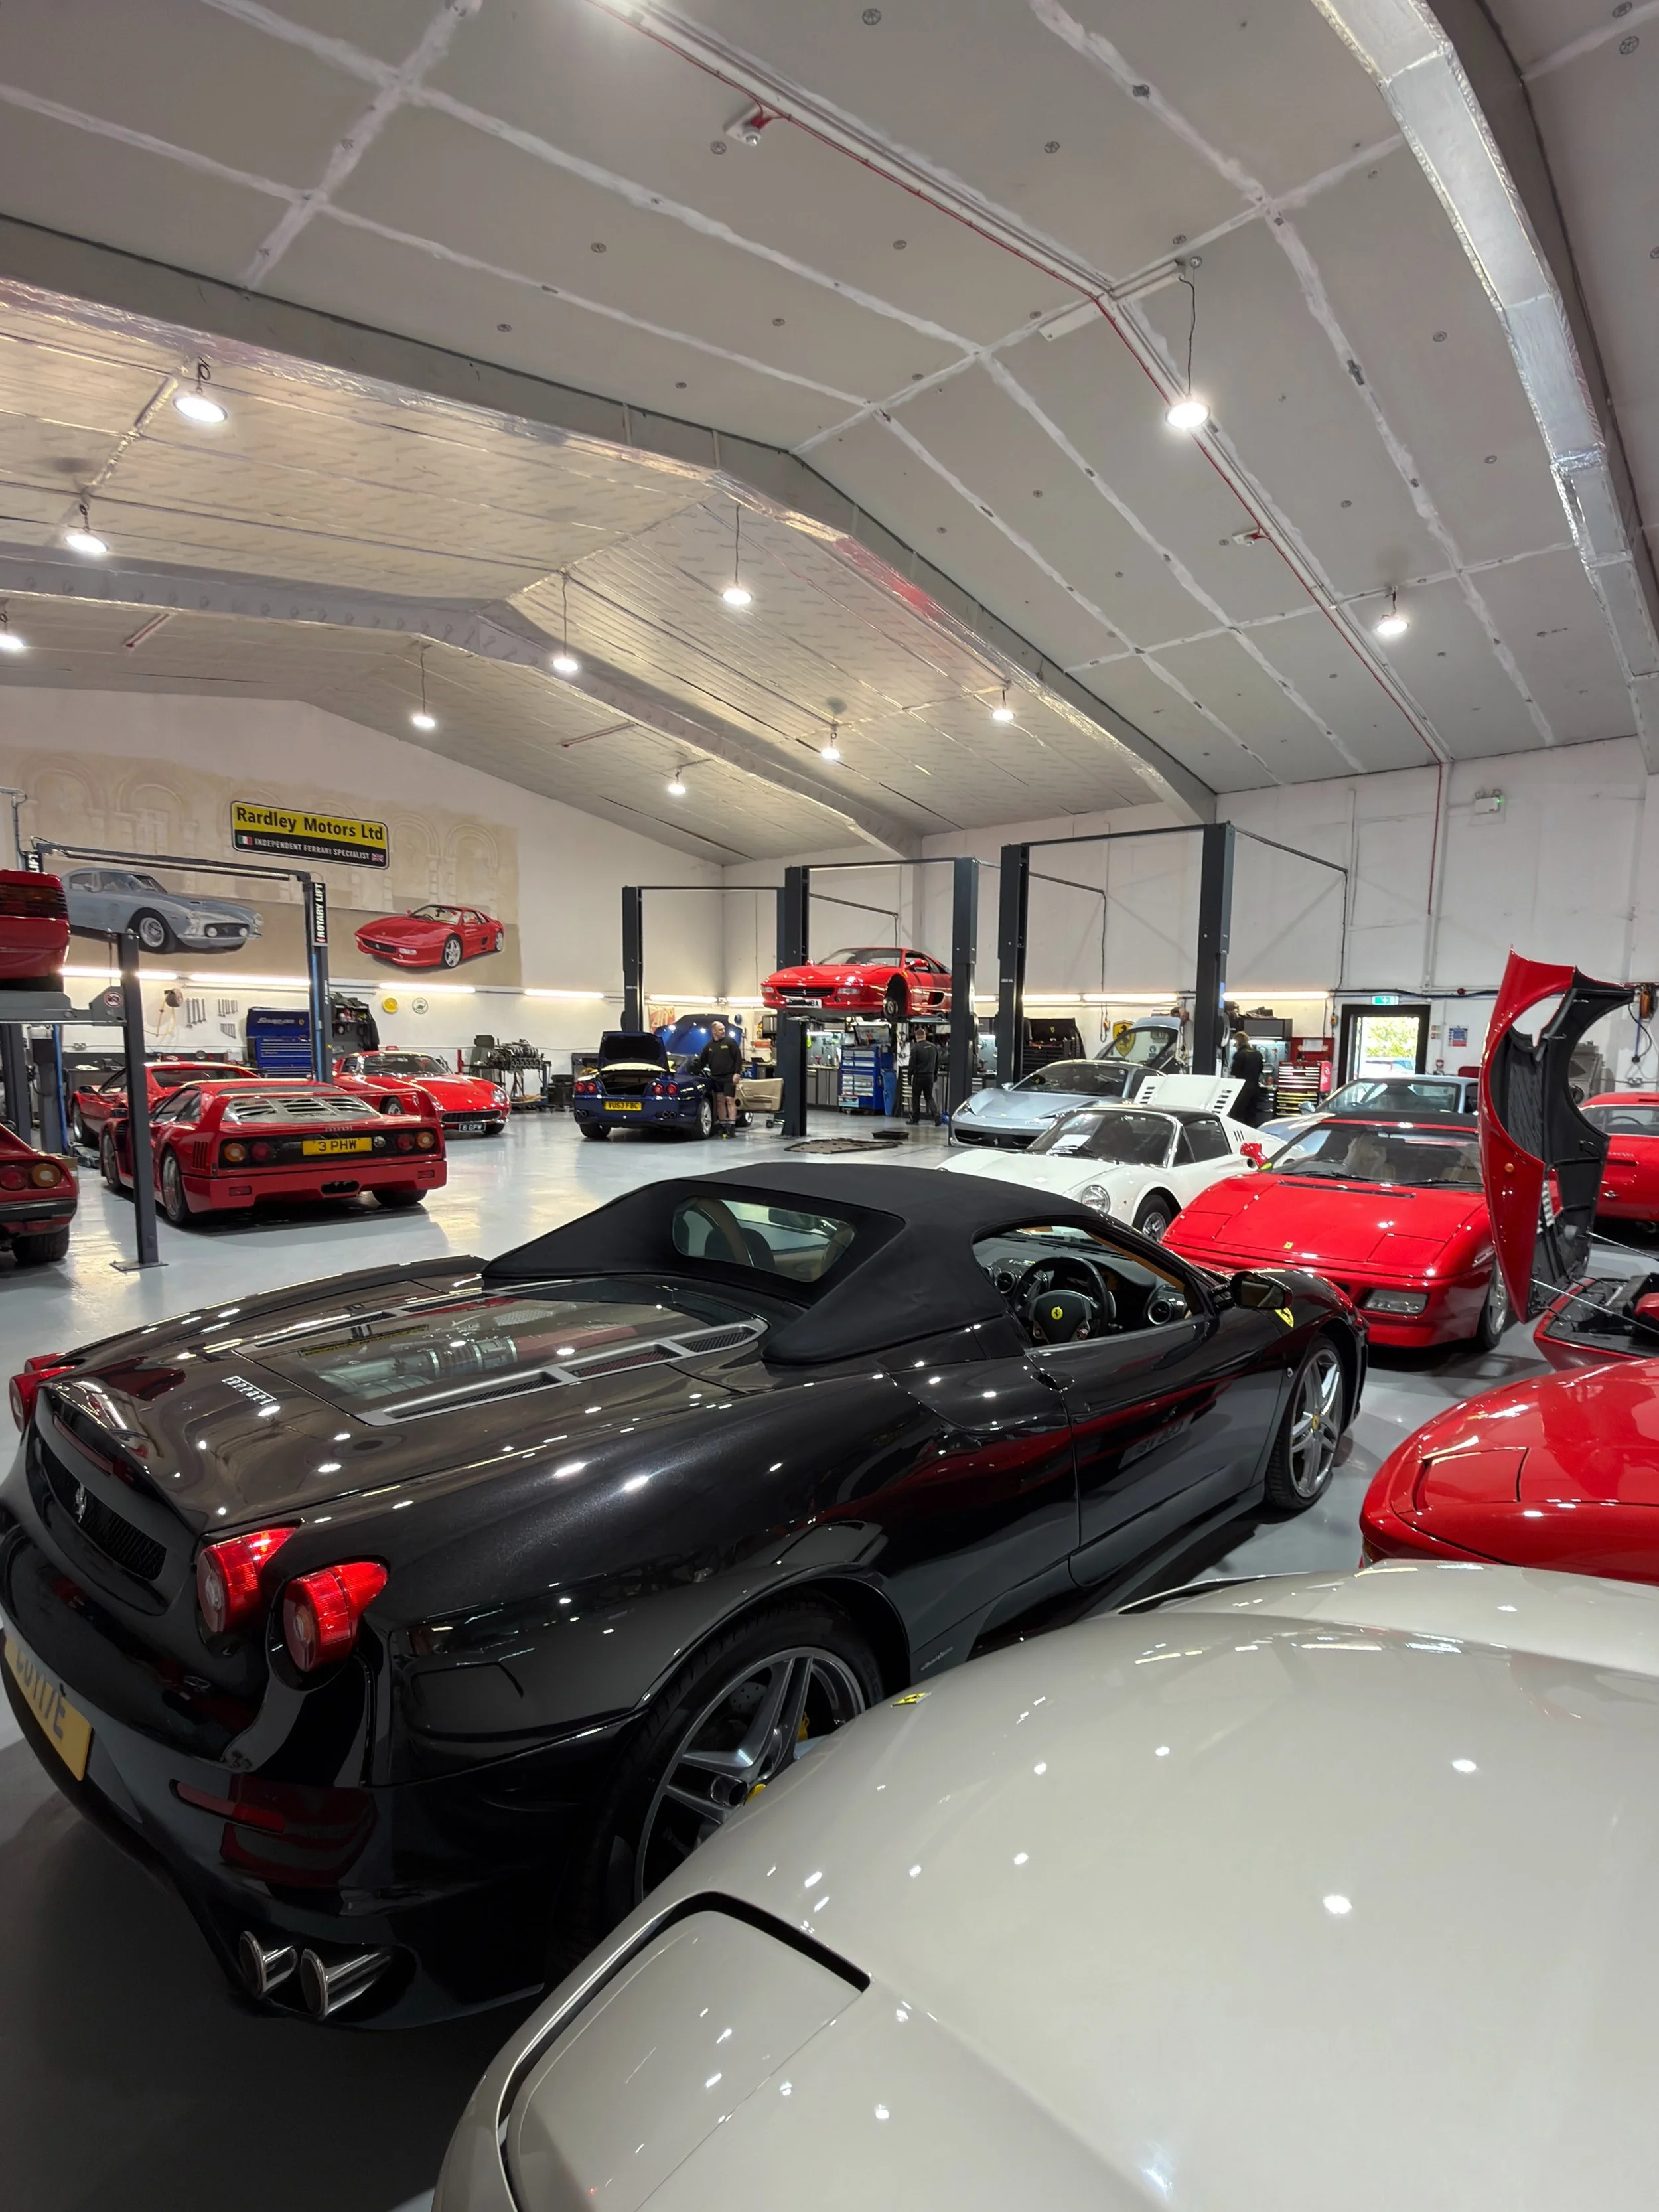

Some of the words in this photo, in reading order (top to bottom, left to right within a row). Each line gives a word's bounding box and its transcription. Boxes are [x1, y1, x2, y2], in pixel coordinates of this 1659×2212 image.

[236, 806, 297, 833] Rardley
[304, 816, 356, 838] Motors
[361, 824, 384, 840] Ltd
[254, 837, 302, 851] INDEPENDENT
[303, 844, 332, 855] FERRARI
[333, 848, 370, 860] SPECIALIST
[315, 883, 324, 903] LIFT
[316, 903, 325, 938] ROTARY
[319, 1141, 326, 1151] 3
[330, 1140, 357, 1151] PHW
